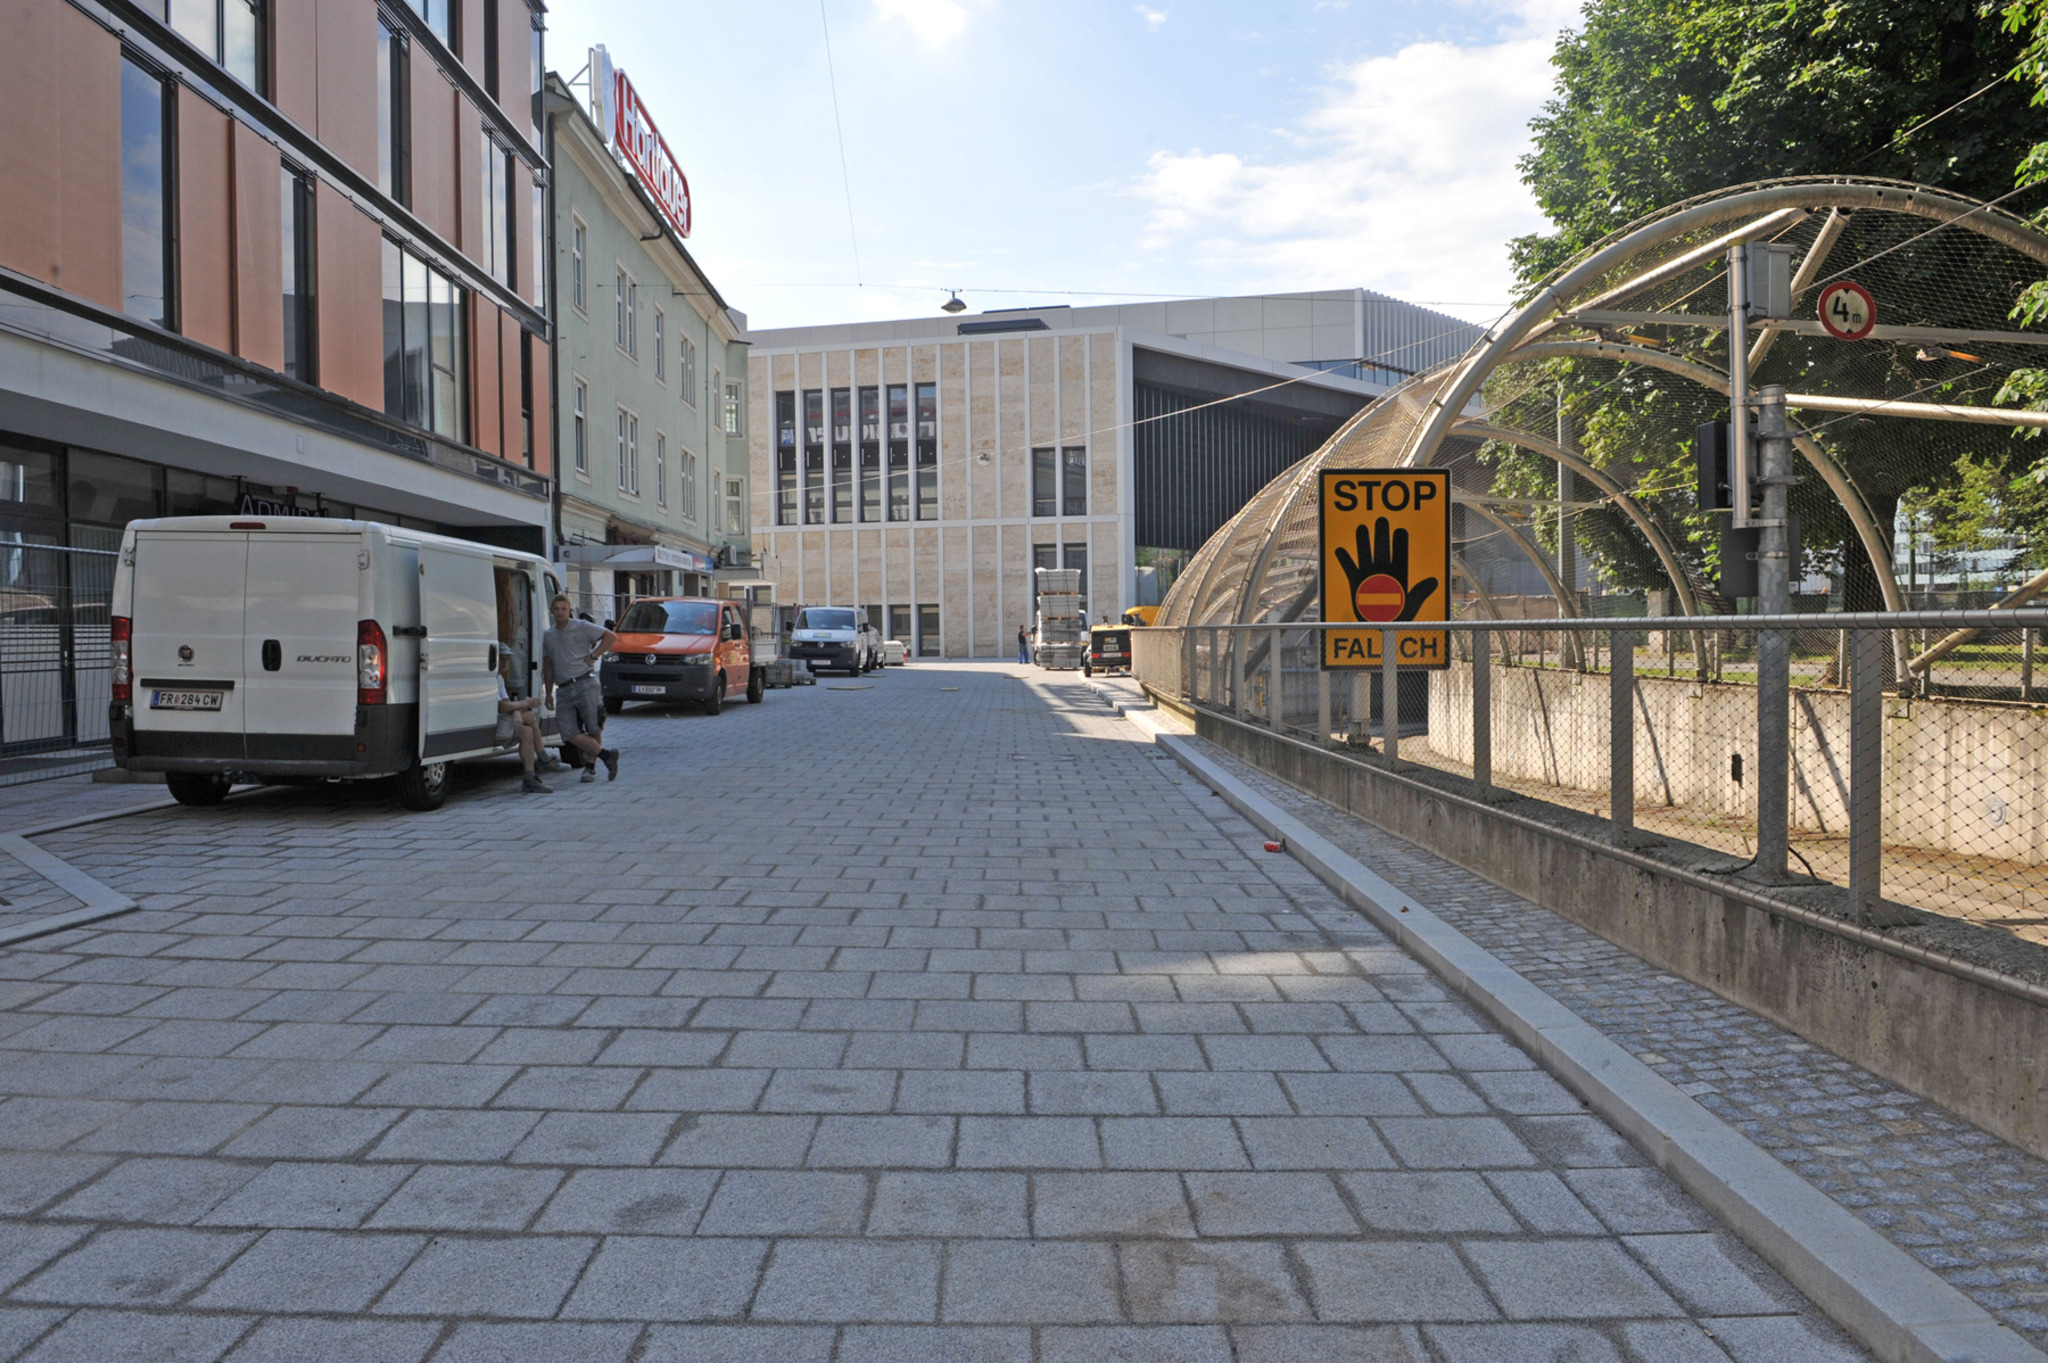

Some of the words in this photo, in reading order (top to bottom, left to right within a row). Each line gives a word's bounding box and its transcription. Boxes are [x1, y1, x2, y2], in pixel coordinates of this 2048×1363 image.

[622, 75, 689, 231] Hartlauer
[1333, 479, 1437, 512] STOP
[296, 654, 352, 663] DUCATO
[1333, 636, 1438, 659] FALCH
[159, 693, 174, 704] FR
[180, 693, 201, 705] 284
[202, 694, 219, 706] CW
